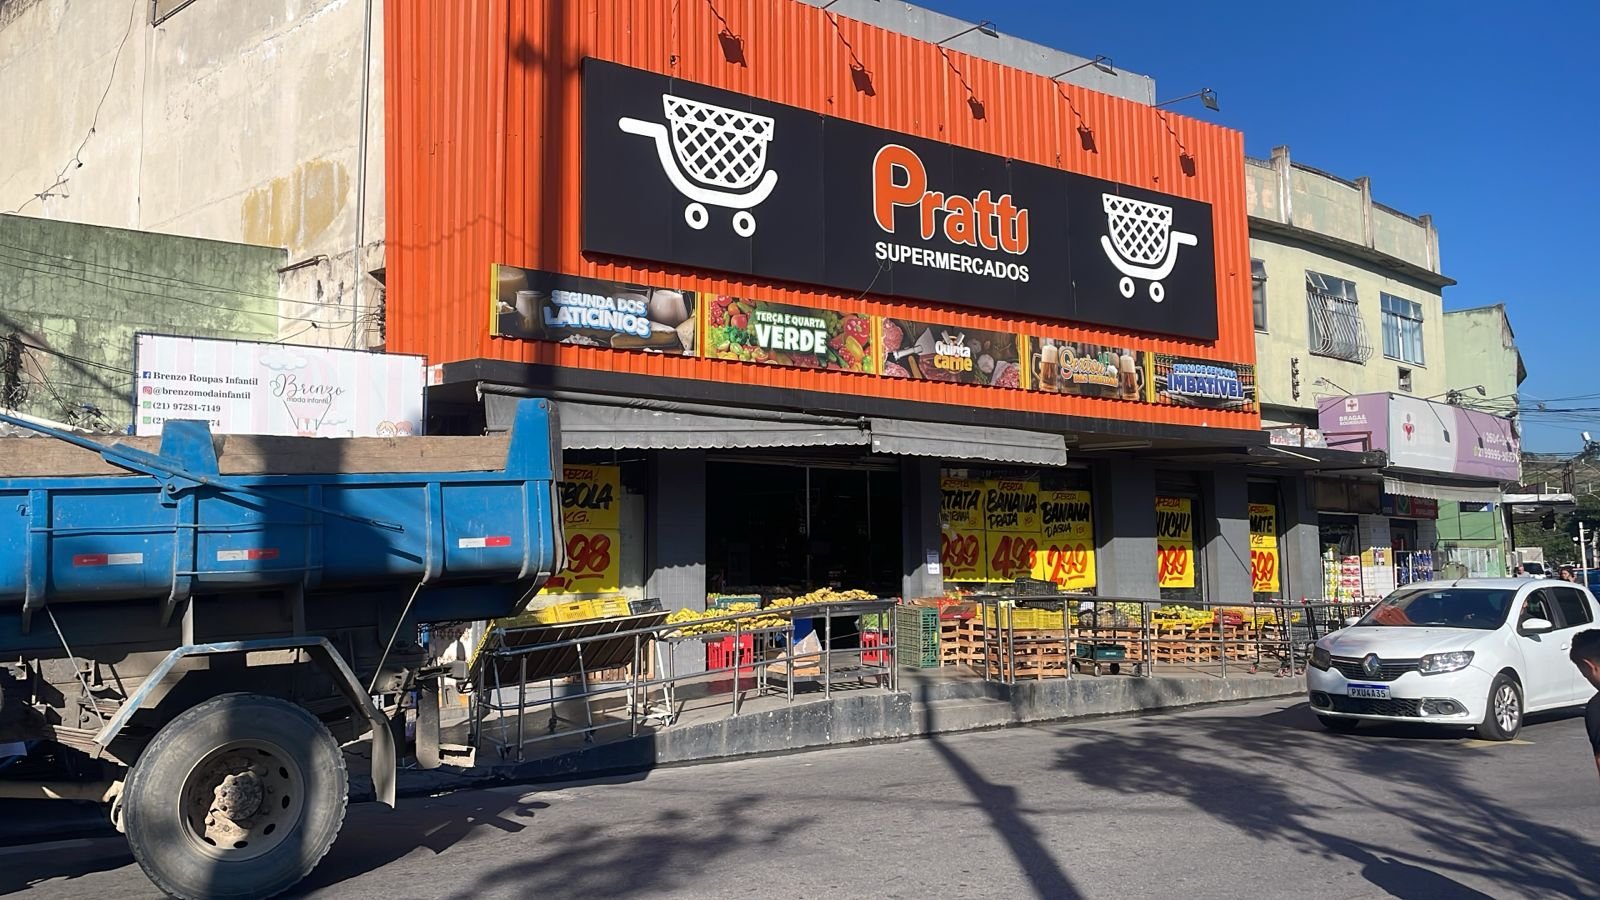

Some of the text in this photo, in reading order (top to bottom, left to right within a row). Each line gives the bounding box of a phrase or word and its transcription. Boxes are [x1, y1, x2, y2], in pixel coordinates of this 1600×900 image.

[875, 241, 1030, 282] SUPERMERCADOS
[551, 289, 647, 316] SEGUNDA DOS
[755, 311, 826, 329] TERÇA E QUARTA
[754, 323, 828, 354] VERDE
[153, 371, 259, 386] Brenzo Roupas Infantil
[269, 373, 346, 402] Brenzo
[152, 386, 251, 399] @brenzomodainfantil
[152, 401, 170, 410] (21)
[986, 488, 1037, 514] BANANA
[987, 512, 1018, 529] PRATA
[1040, 501, 1090, 525] BANANA
[1351, 688, 1386, 698] PXU4A35
